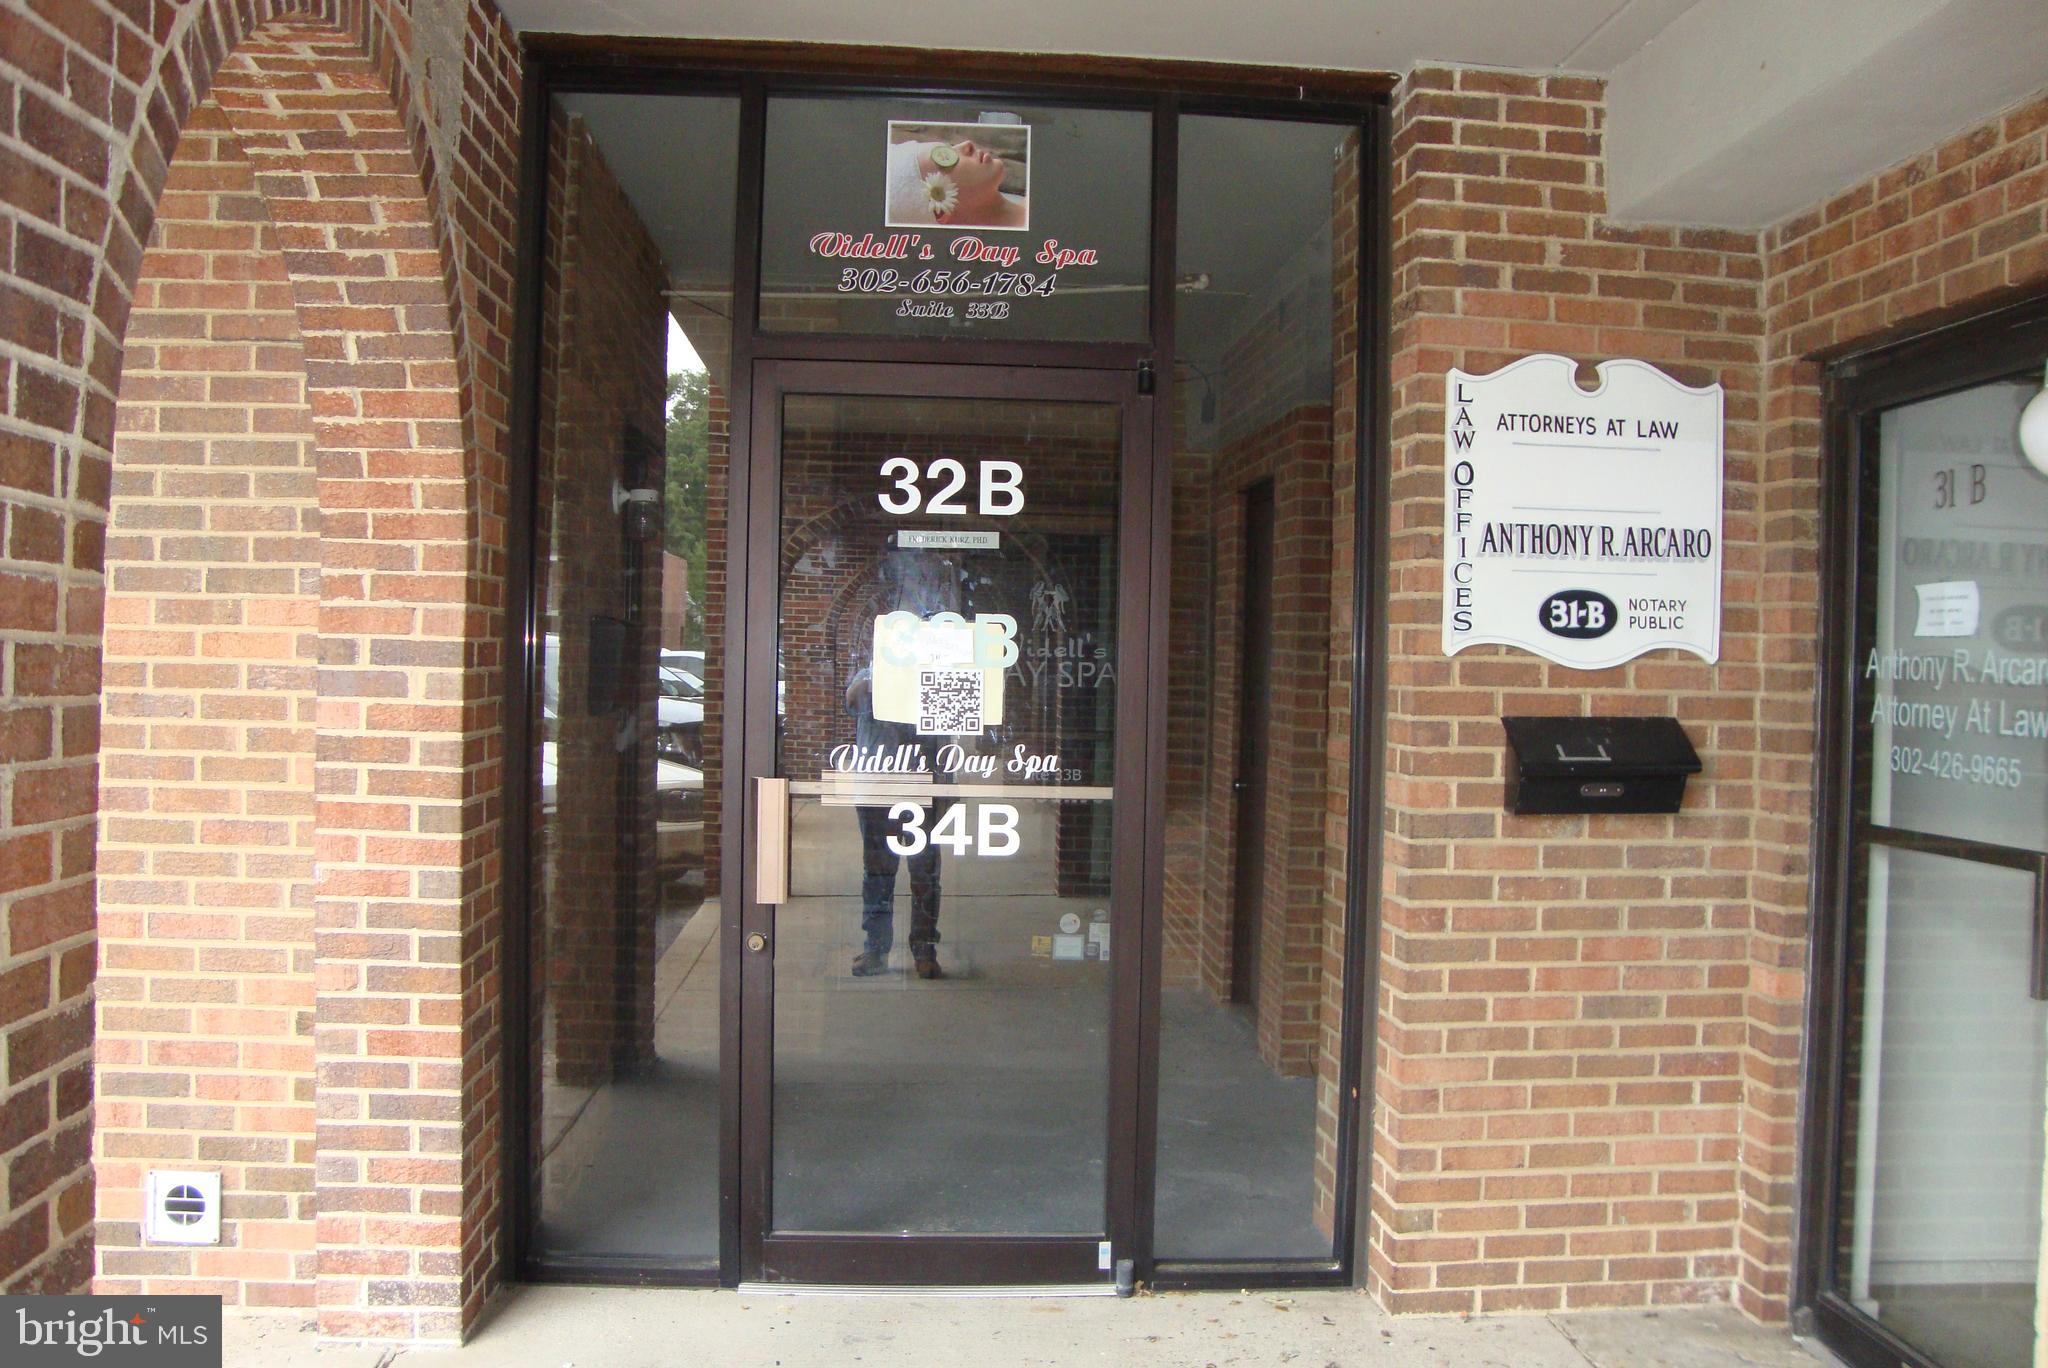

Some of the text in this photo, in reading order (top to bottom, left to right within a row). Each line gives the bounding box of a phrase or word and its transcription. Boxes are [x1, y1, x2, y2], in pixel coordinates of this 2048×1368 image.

[809, 232, 1098, 270] Videll's Day Spa
[837, 267, 1056, 298] 302-656-1784
[896, 299, 1010, 319] Suite 33B
[1496, 413, 1679, 440] ATTORNEYS AT LAW
[877, 457, 1025, 516] 32B
[1969, 463, 1986, 505] B
[1453, 383, 1476, 632] LAW OFFICES
[1481, 522, 1712, 559] ANTHONY R. ARCARO
[1550, 599, 1606, 629] 31-B
[1629, 598, 1687, 613] NOTARY
[1629, 616, 1684, 630] PUBLIC
[1057, 661, 1117, 688] SPA
[1866, 647, 2048, 690] Anthony R. Arcar
[1871, 693, 1958, 740] Attorney
[1965, 698, 1991, 734] At
[829, 744, 1060, 779] Videll's Day Spa
[1891, 746, 2021, 788] 302-426-9665
[886, 802, 1020, 856] 34B
